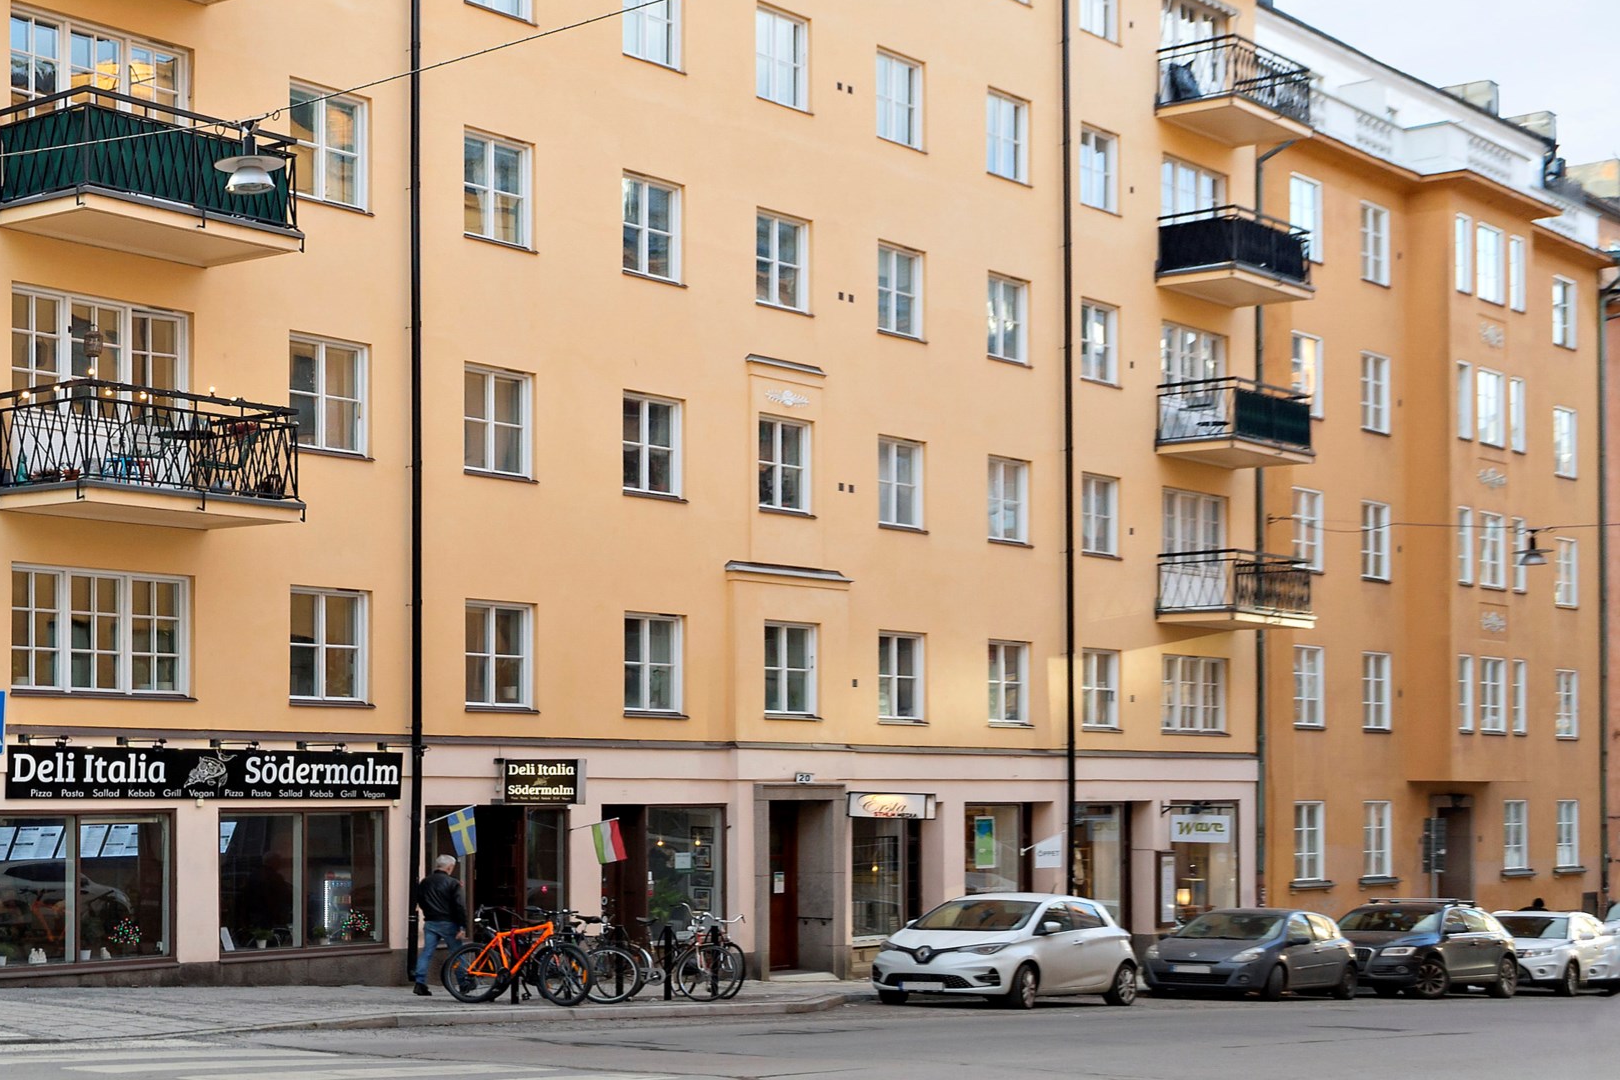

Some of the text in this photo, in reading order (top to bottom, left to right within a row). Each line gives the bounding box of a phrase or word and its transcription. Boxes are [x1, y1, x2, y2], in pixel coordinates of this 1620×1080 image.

[11, 752, 399, 785] Deli Italia Södermalm
[508, 763, 575, 776] Deli Italia
[799, 774, 811, 782] 20
[30, 789, 386, 799] Pizza Pasta Sallad Kebab Grill Vegan Pizza Pasta Sallad Kebab Grill Vegan
[507, 784, 575, 795] Södermalm
[1177, 822, 1226, 835] Wave
